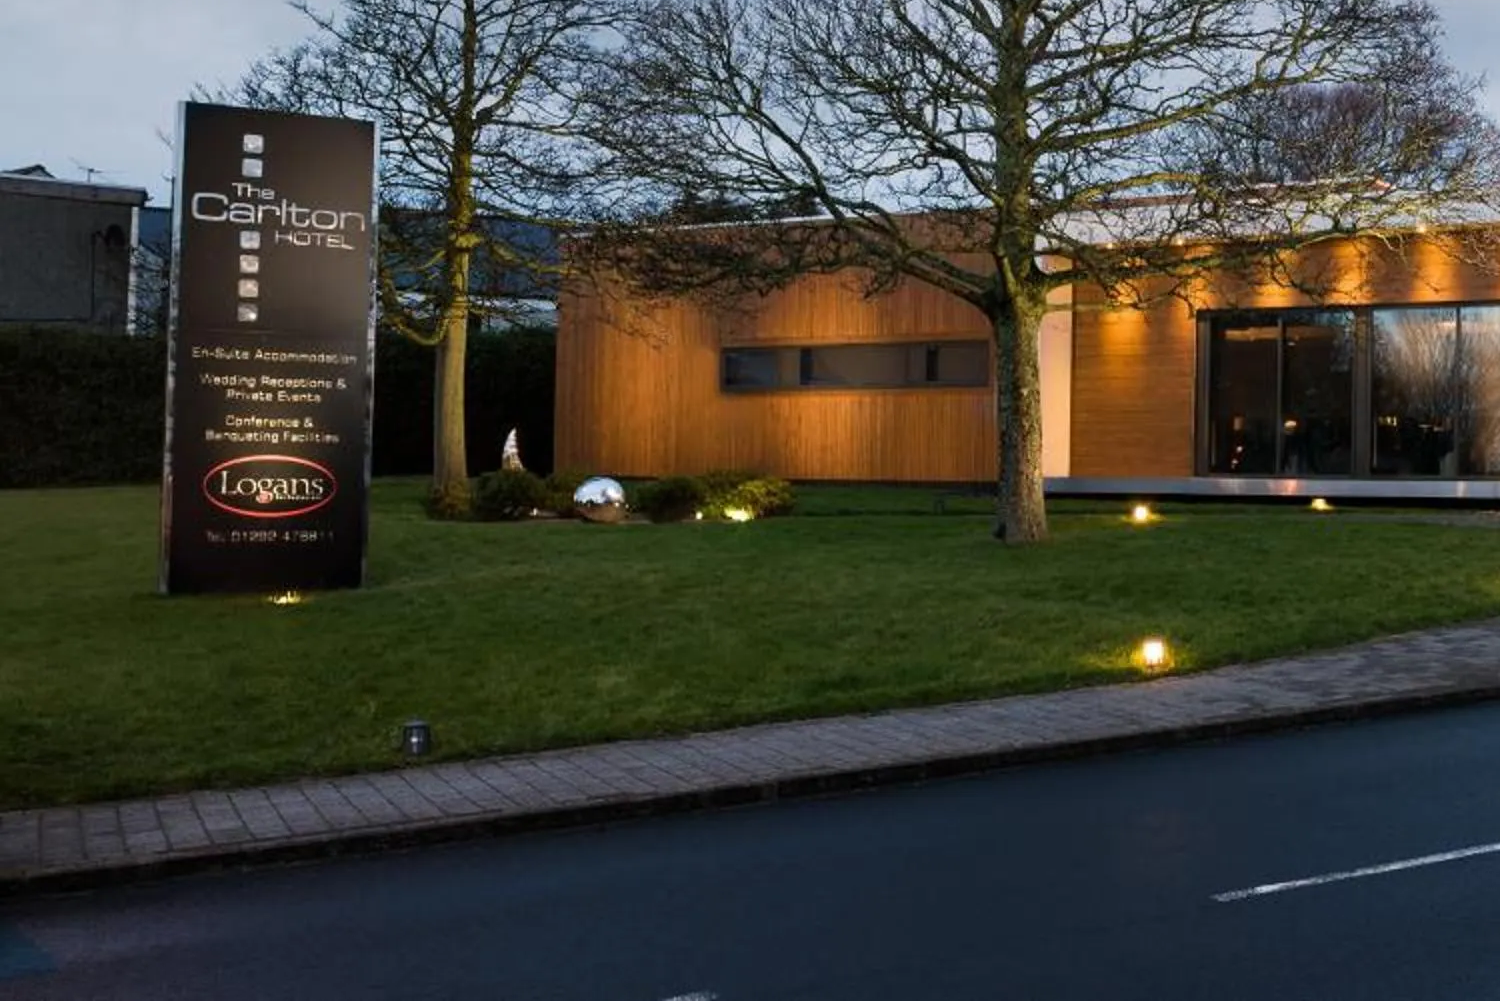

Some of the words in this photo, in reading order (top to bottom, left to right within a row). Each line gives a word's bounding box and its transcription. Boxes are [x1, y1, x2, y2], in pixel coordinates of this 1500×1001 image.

[231, 181, 275, 199] The
[191, 192, 366, 232] Carlton
[275, 230, 355, 250] HOTEL
[201, 373, 257, 388] Wedding
[261, 375, 332, 389] Receptions
[336, 377, 347, 389] &
[226, 389, 273, 402] Private
[277, 390, 322, 403] Events
[225, 414, 300, 428] Conference
[303, 417, 314, 428] &
[220, 470, 324, 504] Logans
